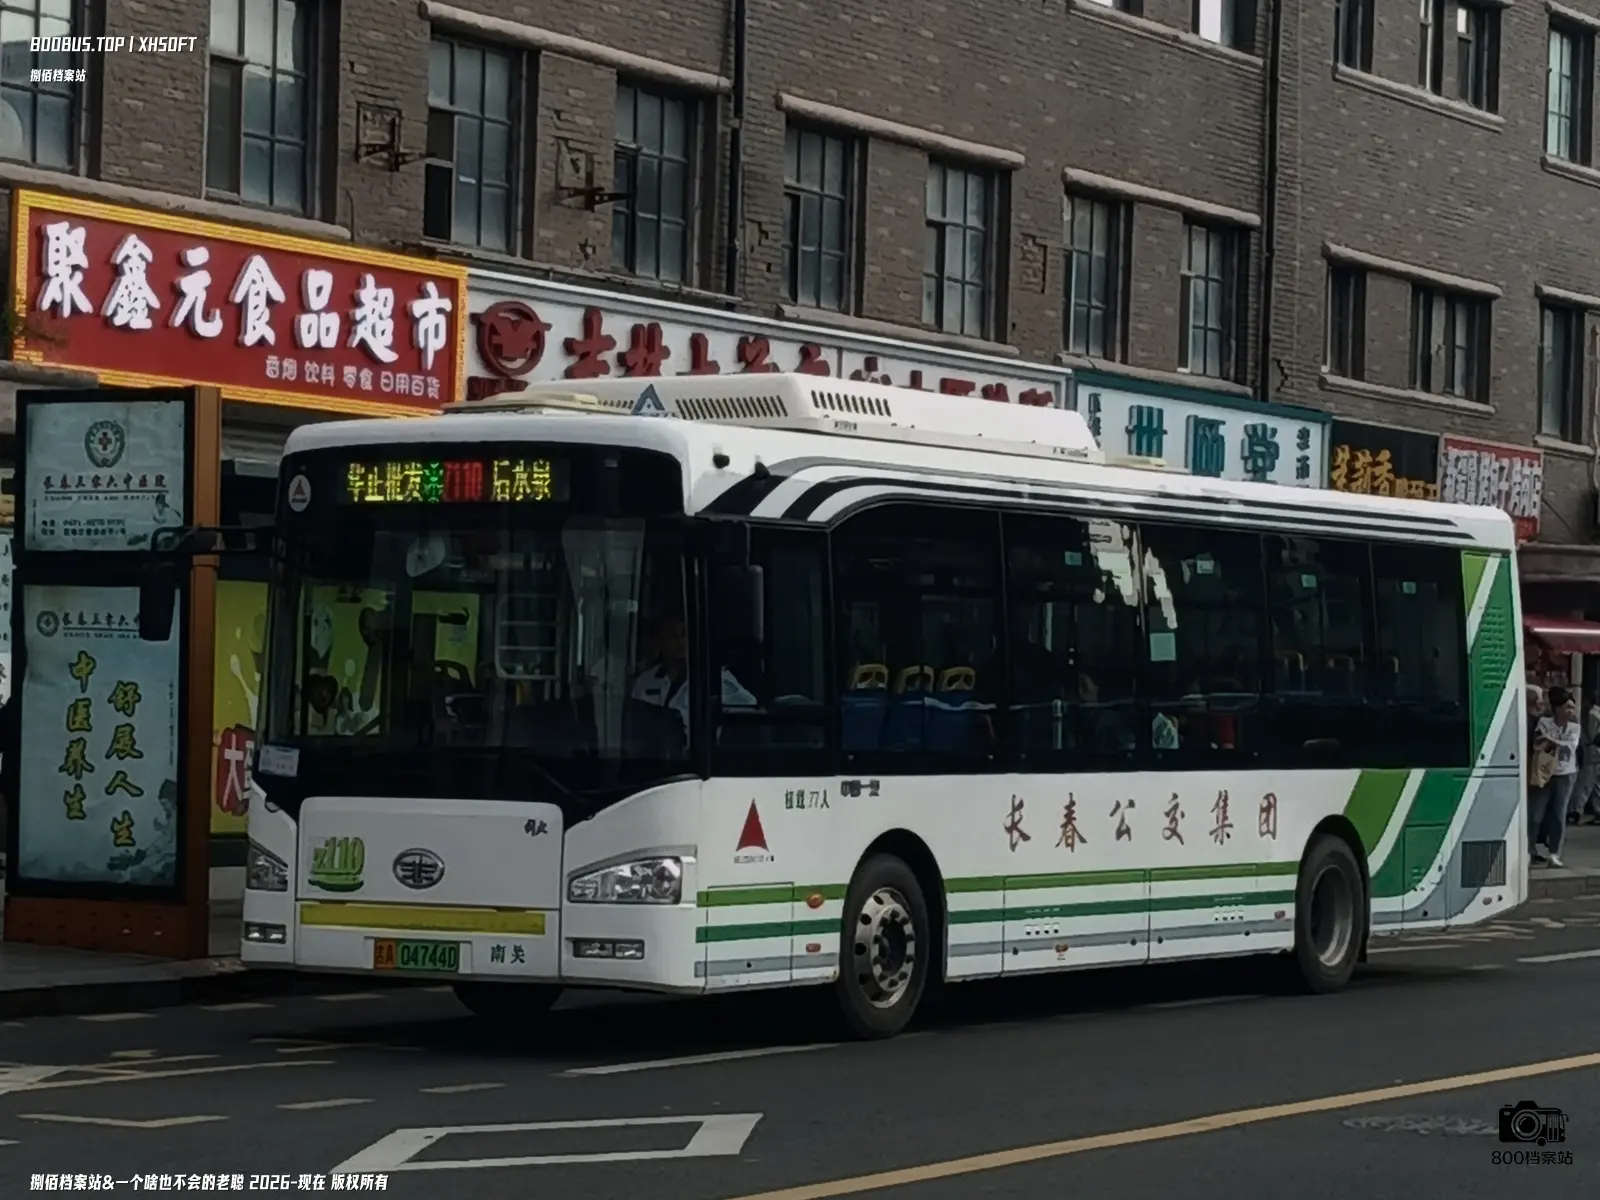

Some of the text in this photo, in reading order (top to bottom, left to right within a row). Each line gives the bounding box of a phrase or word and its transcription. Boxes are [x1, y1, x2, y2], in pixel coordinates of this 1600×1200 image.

[41, 221, 453, 371] 聚鑫元食品超市
[304, 360, 336, 388] 饮料
[343, 365, 374, 391] 零食
[380, 371, 441, 401] 日用百货
[60, 650, 97, 820] 中医养生
[105, 680, 144, 848] 舒展人生
[1003, 790, 1279, 852] 长春公交集团
[490, 944, 526, 964] 南关
